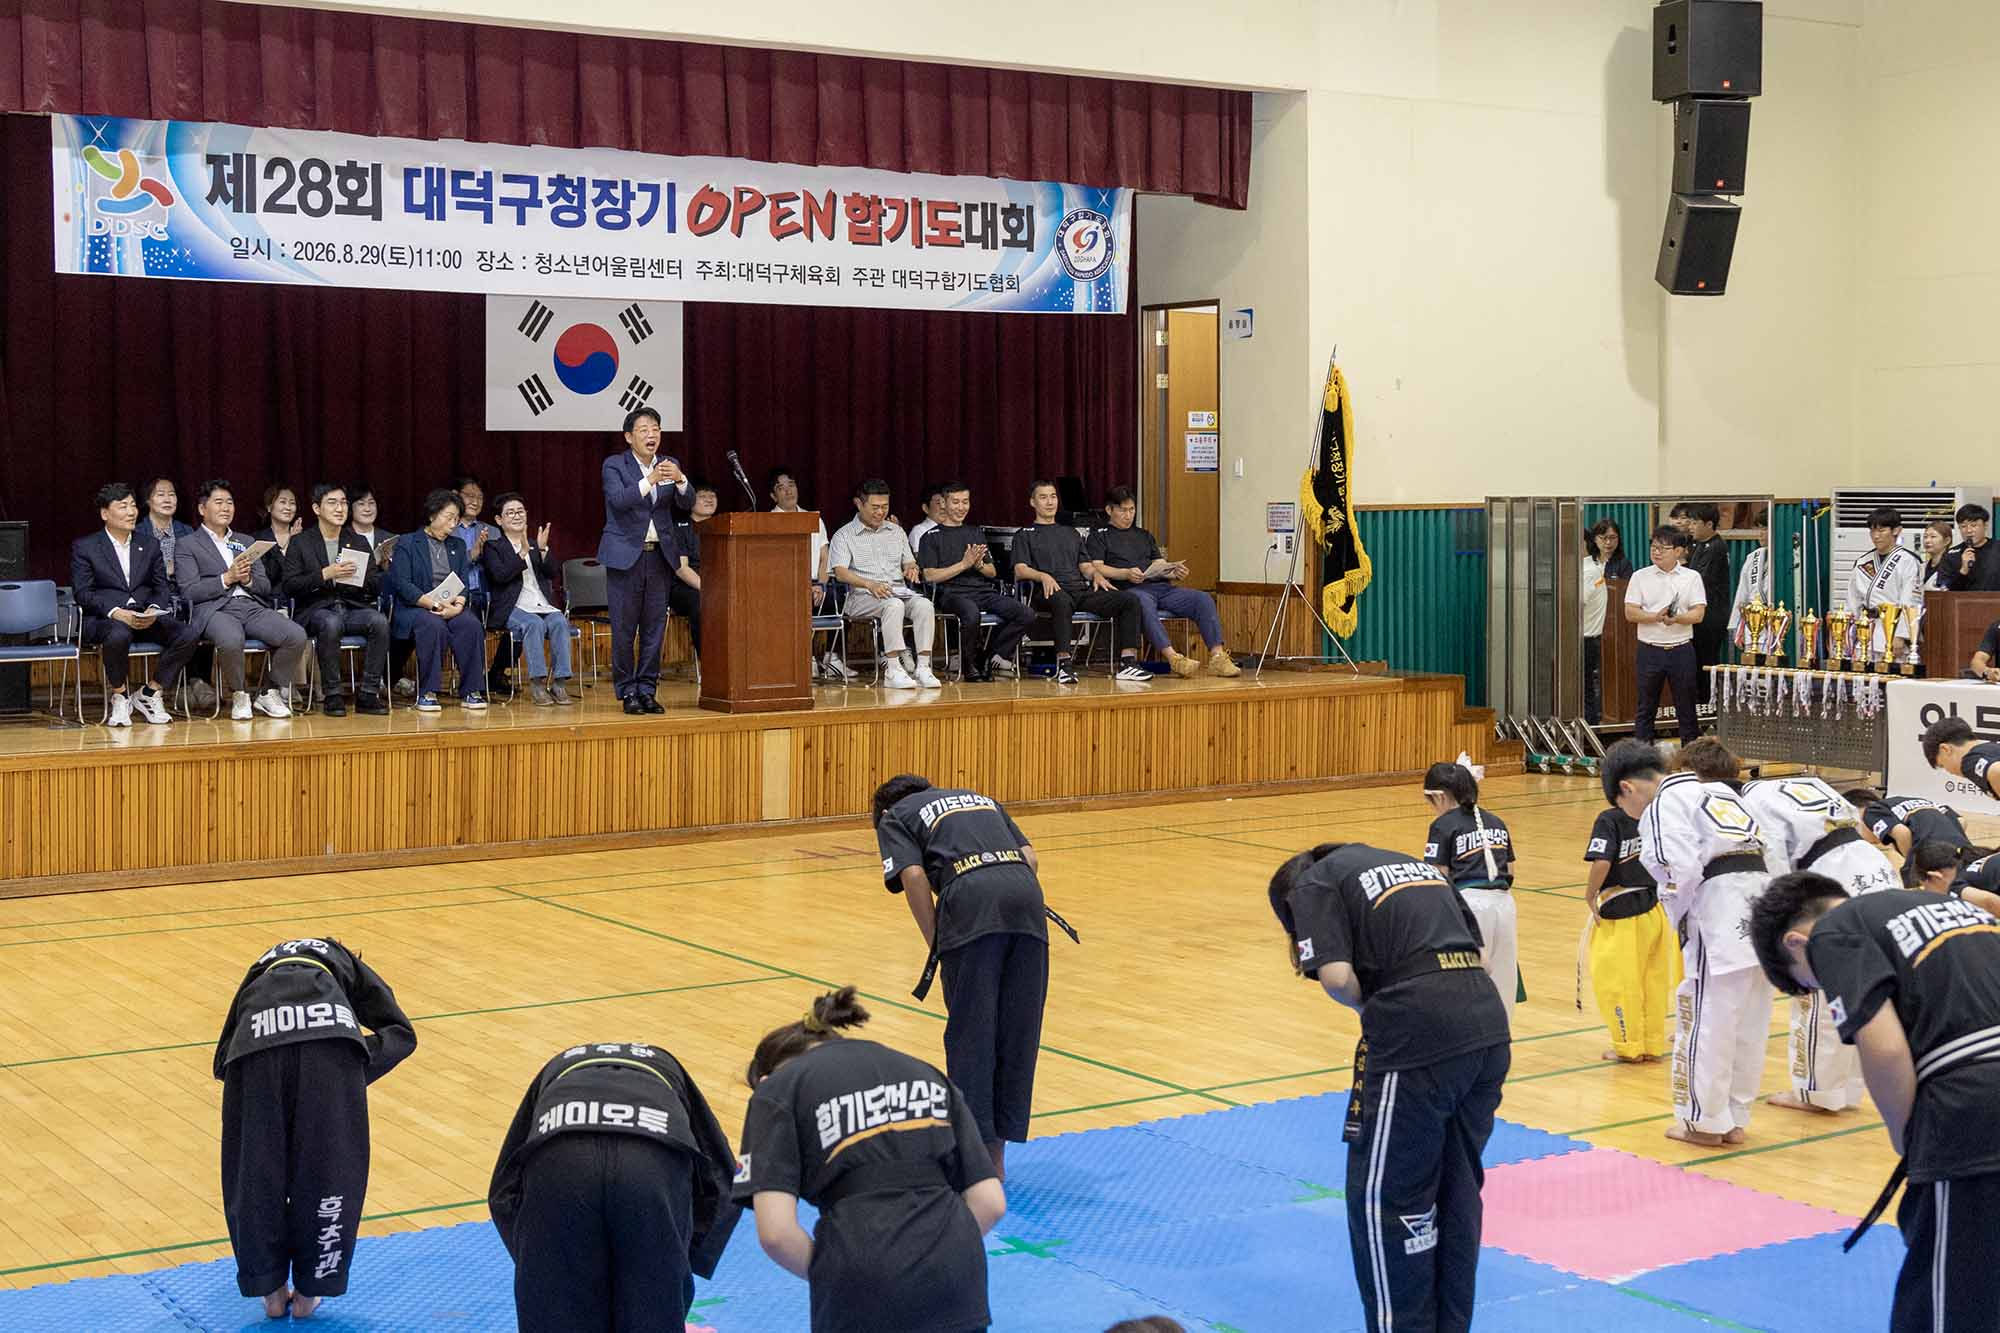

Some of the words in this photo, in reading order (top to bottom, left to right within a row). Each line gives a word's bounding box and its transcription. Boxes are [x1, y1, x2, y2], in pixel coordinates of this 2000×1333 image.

[205, 152, 383, 222] 제28회
[403, 166, 677, 234] 대덕구청장기
[686, 183, 837, 243] OPEN
[843, 191, 1035, 253] 합기도대회
[230, 237, 271, 261] 일시
[293, 240, 462, 270] 2026.8.29(토)11:00
[476, 250, 514, 273] 장소
[535, 253, 683, 280] 청소년어울림센터
[696, 259, 841, 287] 주최:대덕구체육회
[852, 267, 885, 289] 주관
[892, 268, 1021, 293] 대덕구합기도협회
[953, 854, 982, 875] BLACK
[995, 850, 1022, 862] EAGLE
[538, 1101, 669, 1135] 케이오투
[815, 1079, 948, 1150] 합기도선수단
[314, 1195, 343, 1279] 흑추관
